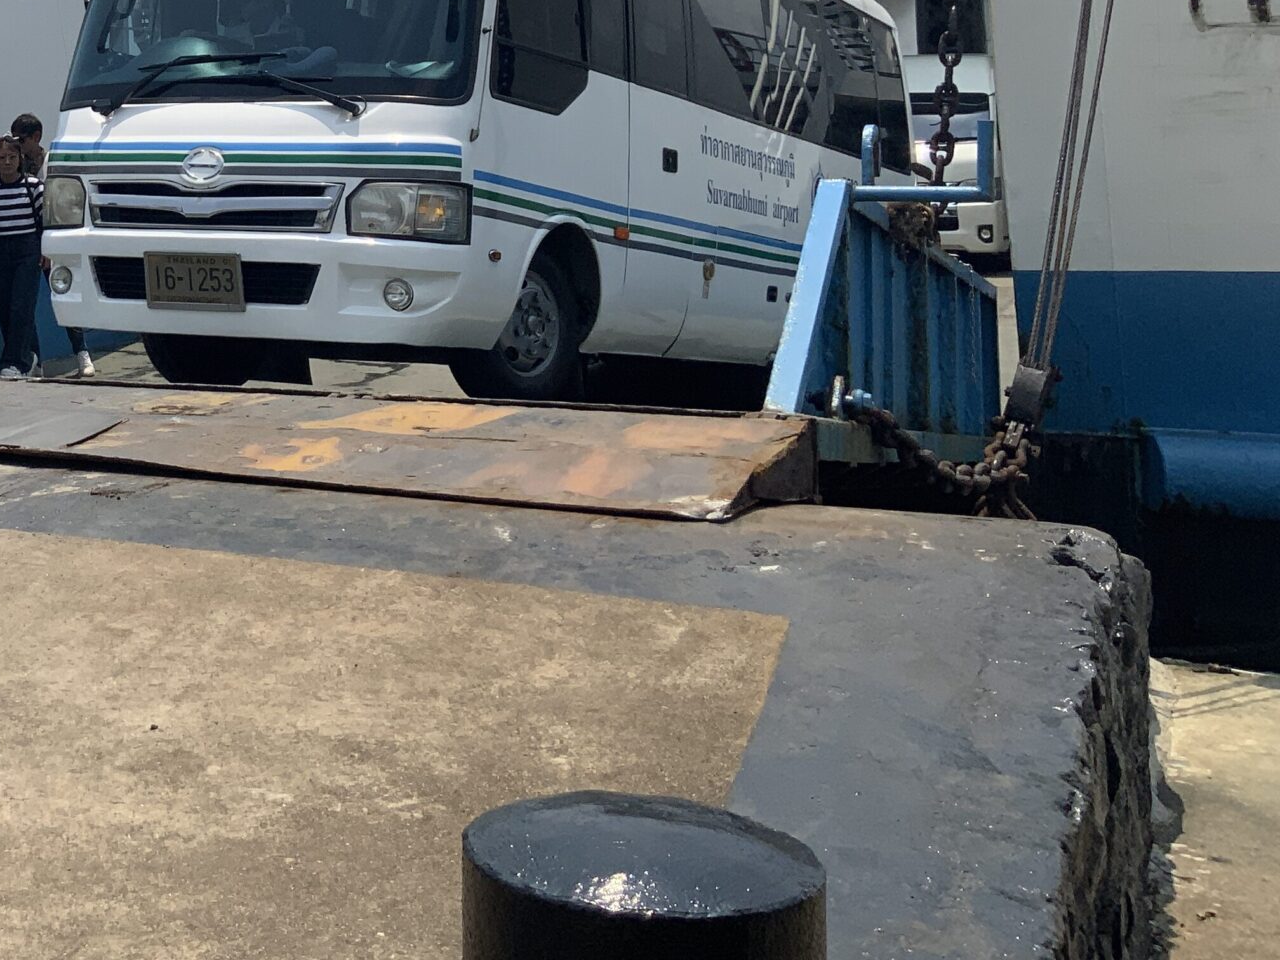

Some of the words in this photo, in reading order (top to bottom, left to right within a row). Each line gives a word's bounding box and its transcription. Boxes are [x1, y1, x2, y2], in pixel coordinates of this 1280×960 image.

[700, 125, 796, 188] ท่าอากาศยานสุวรรณภูมิ
[706, 178, 768, 217] Suvarnabhumi
[772, 196, 800, 227] airport
[155, 264, 235, 293] 16-1253
[167, 256, 216, 265] THAILAND
